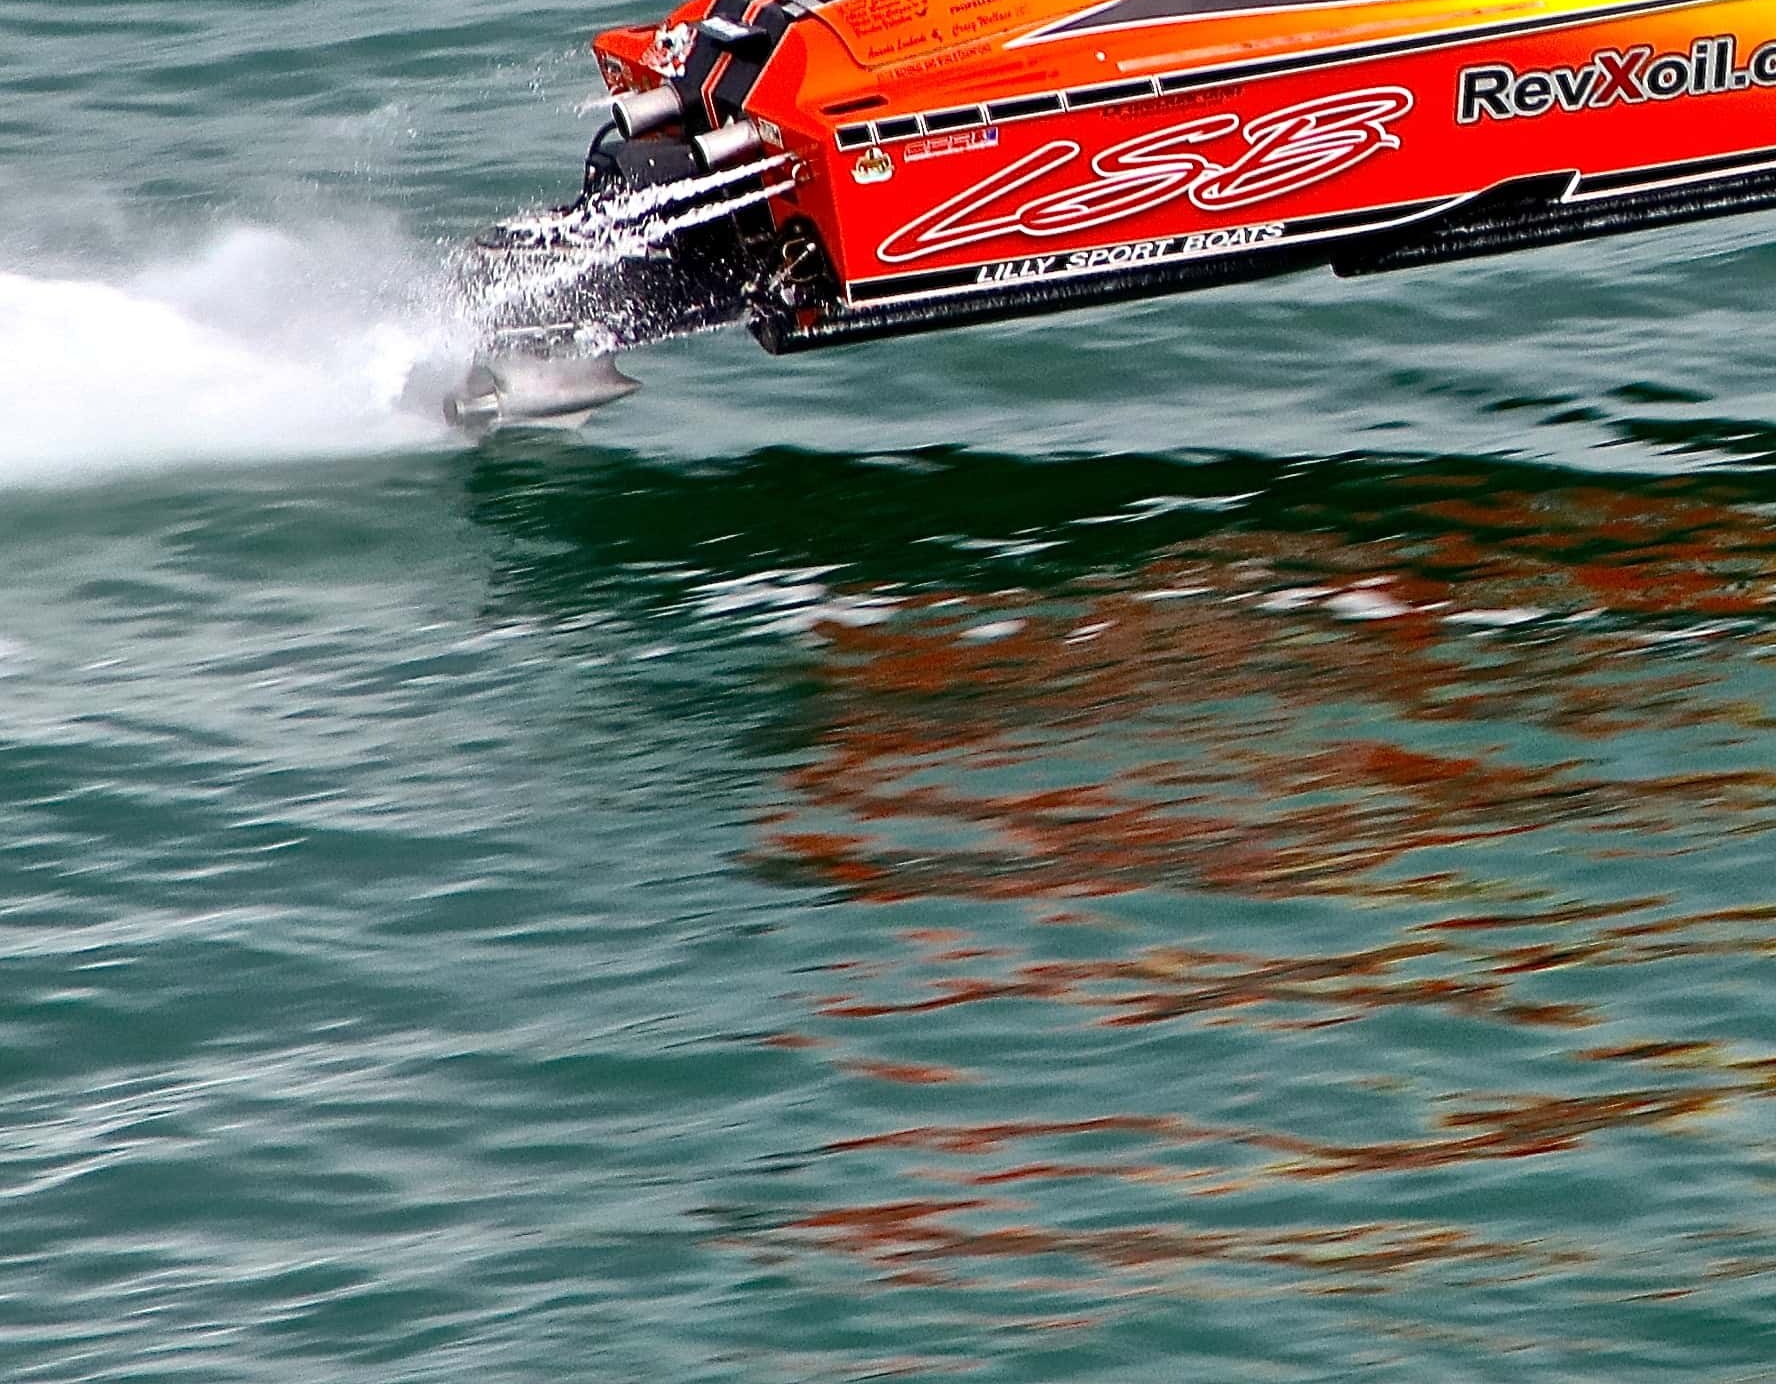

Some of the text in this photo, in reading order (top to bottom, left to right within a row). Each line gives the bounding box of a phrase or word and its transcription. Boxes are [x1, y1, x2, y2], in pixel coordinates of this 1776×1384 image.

[876, 85, 1414, 263] LSB
[975, 221, 1287, 284] LILLY SPORT BOATS
